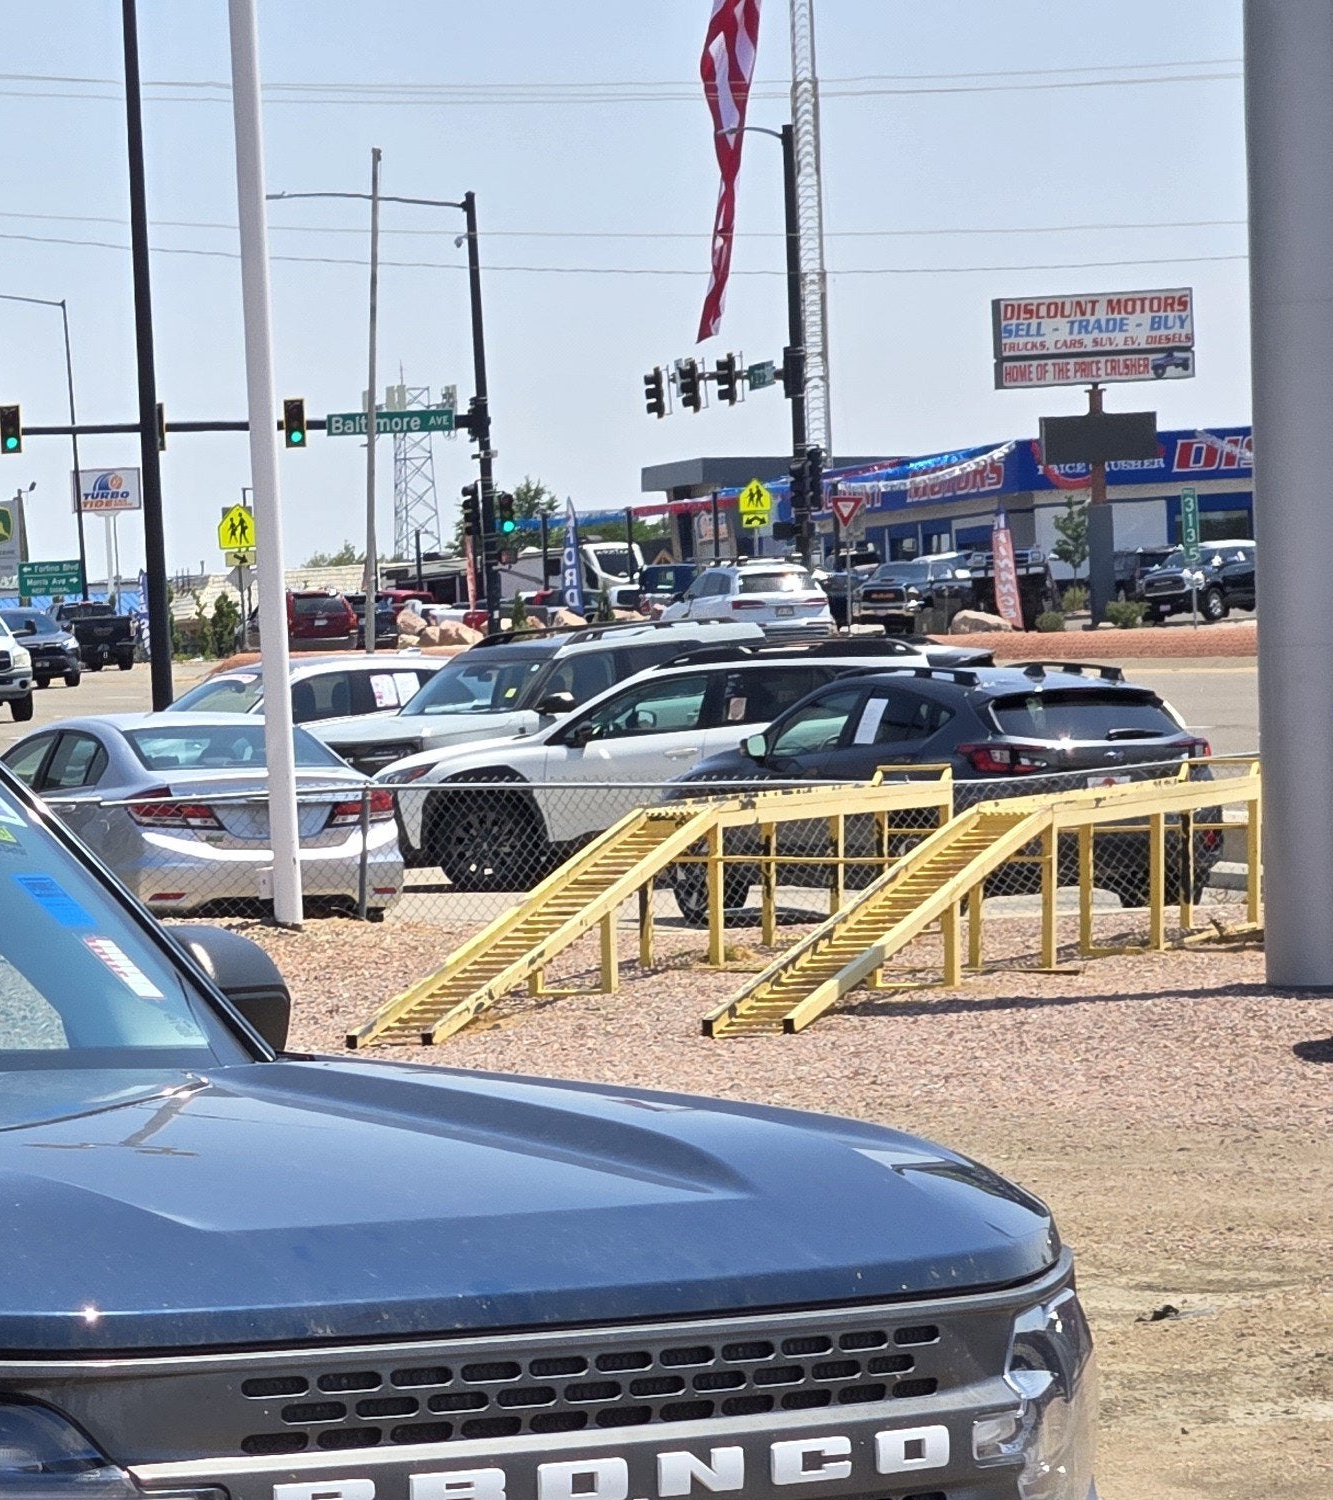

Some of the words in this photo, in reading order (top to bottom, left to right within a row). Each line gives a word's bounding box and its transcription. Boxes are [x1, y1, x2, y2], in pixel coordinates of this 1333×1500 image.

[1003, 301, 1099, 321] DISCOUNT
[1106, 295, 1189, 315] MOTORS
[1002, 322, 1046, 339] SELL
[1067, 317, 1130, 335] TRADE
[1150, 314, 1189, 332] BUY
[1002, 340, 1050, 353] TRUCKS,
[1054, 338, 1087, 350] CARS,
[1092, 336, 1119, 348] SUV,
[1123, 335, 1141, 347] EV,
[1145, 333, 1192, 346] DIESELS
[1004, 363, 1035, 383] HOME
[1036, 363, 1049, 381] OF
[1052, 361, 1071, 380] THE
[1073, 360, 1102, 379] PRICE
[1105, 357, 1150, 376] CRUSHER
[332, 415, 421, 433] Baltmore
[428, 415, 449, 426] AVE
[1089, 458, 1165, 472] USHER
[82, 500, 113, 508] TIDE
[83, 490, 130, 500] TURBO
[1183, 497, 1201, 561] 3135
